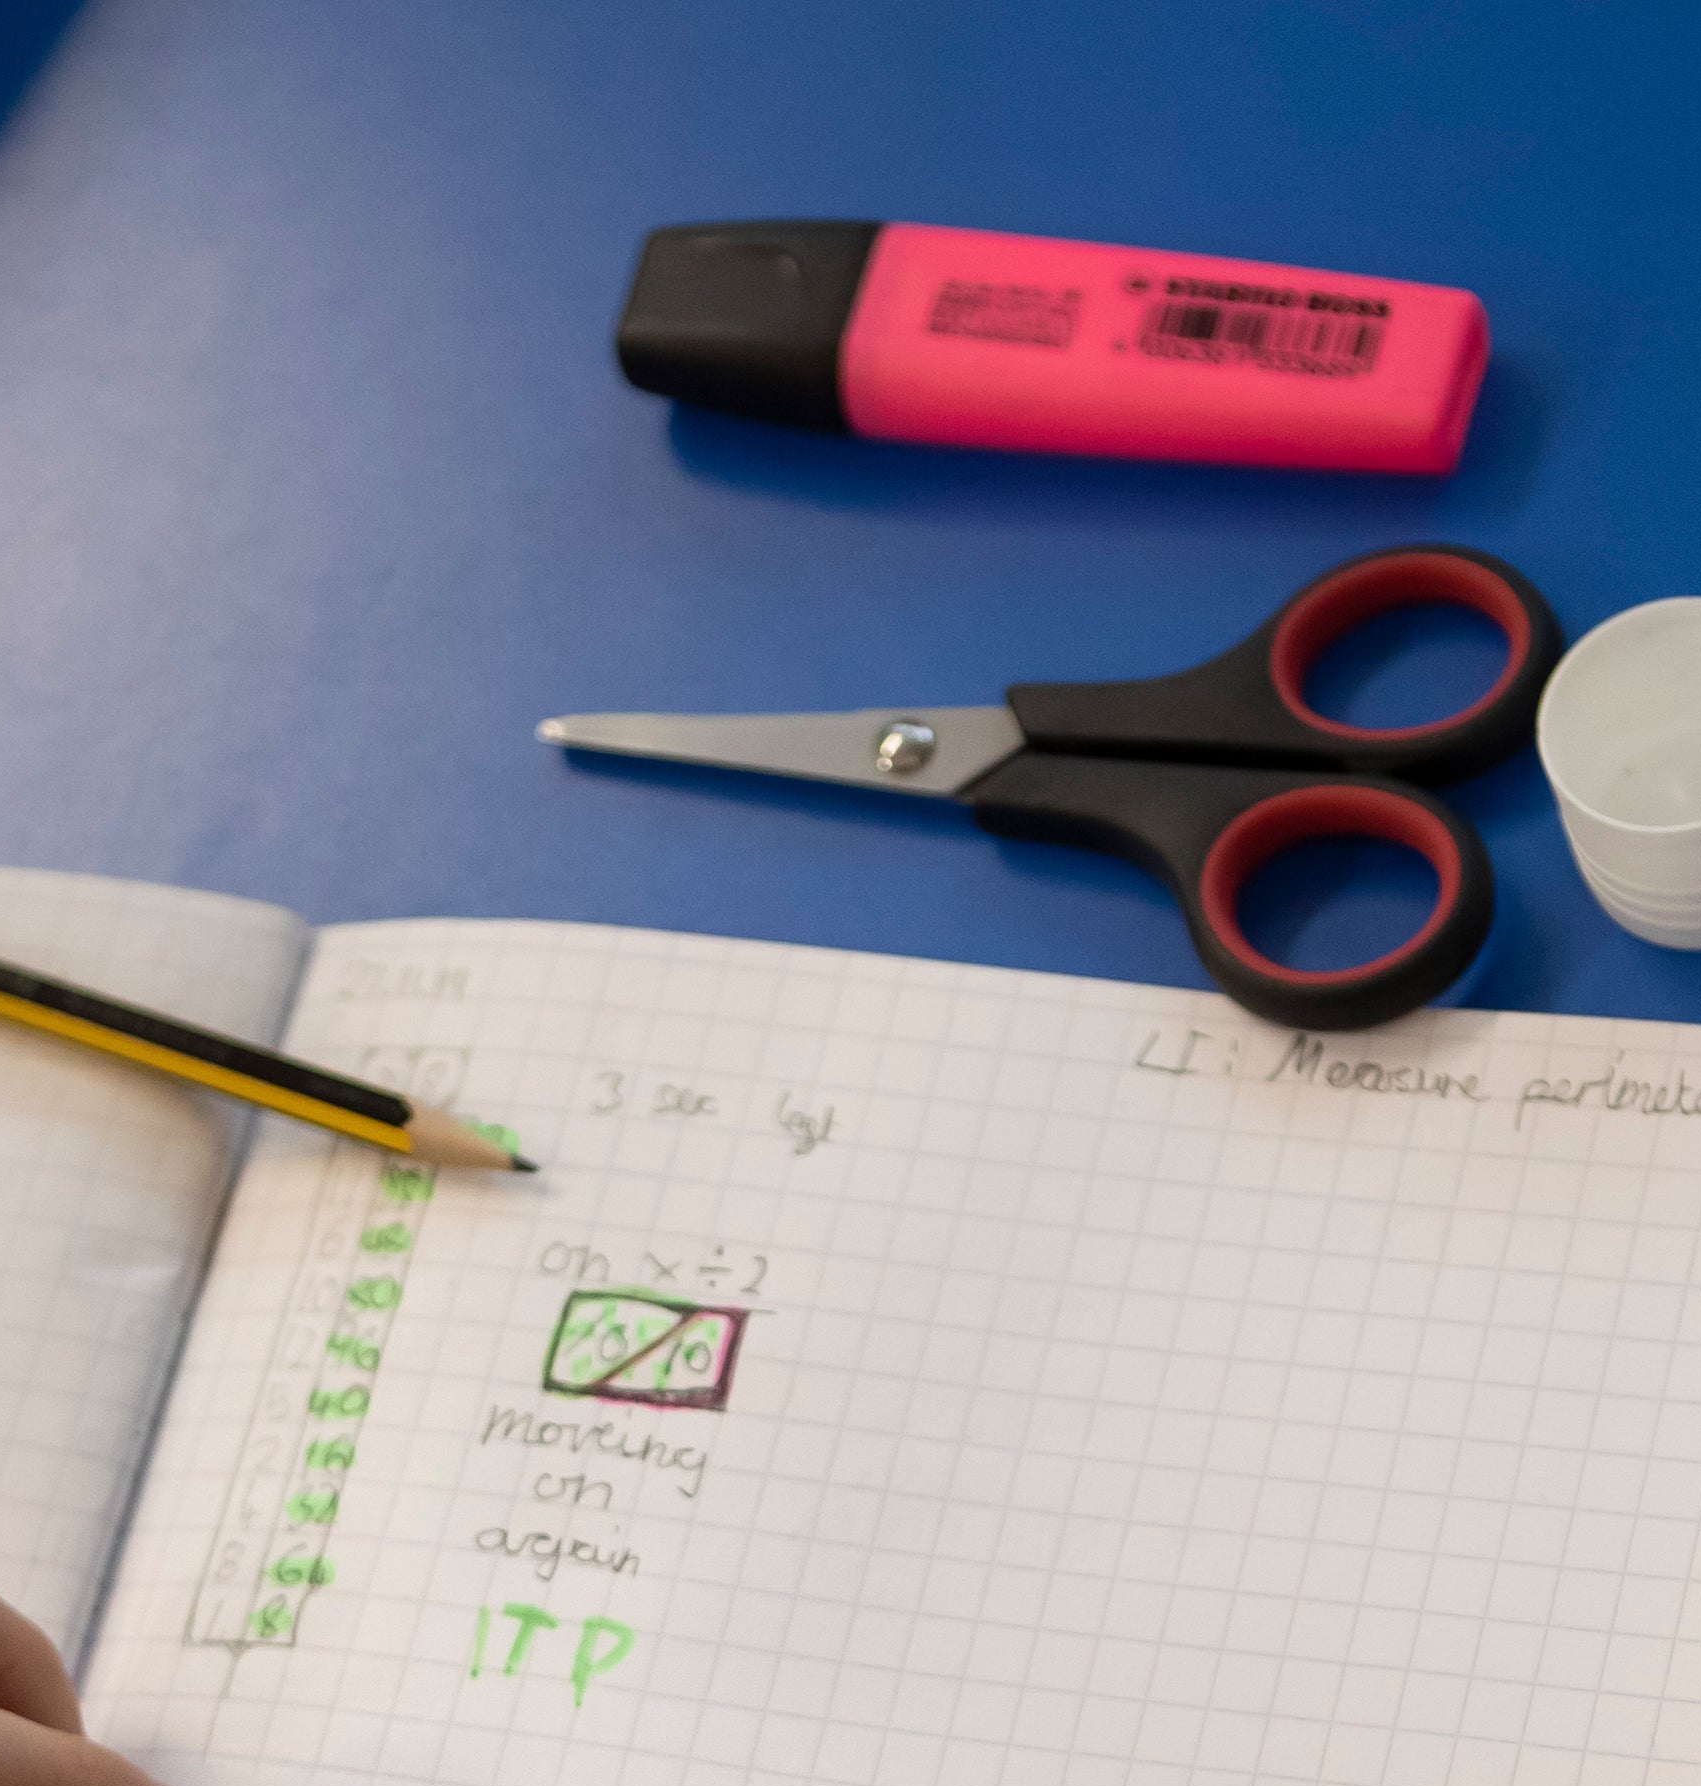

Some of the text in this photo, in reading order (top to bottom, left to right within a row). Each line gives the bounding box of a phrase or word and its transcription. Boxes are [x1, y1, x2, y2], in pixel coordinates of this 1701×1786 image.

[590, 1070, 624, 1117] 3
[1266, 1034, 1490, 1101] Measure
[539, 1240, 611, 1281] on
[535, 1471, 613, 1511] on
[475, 1525, 642, 1582] again
[470, 1602, 635, 1709] ITP
